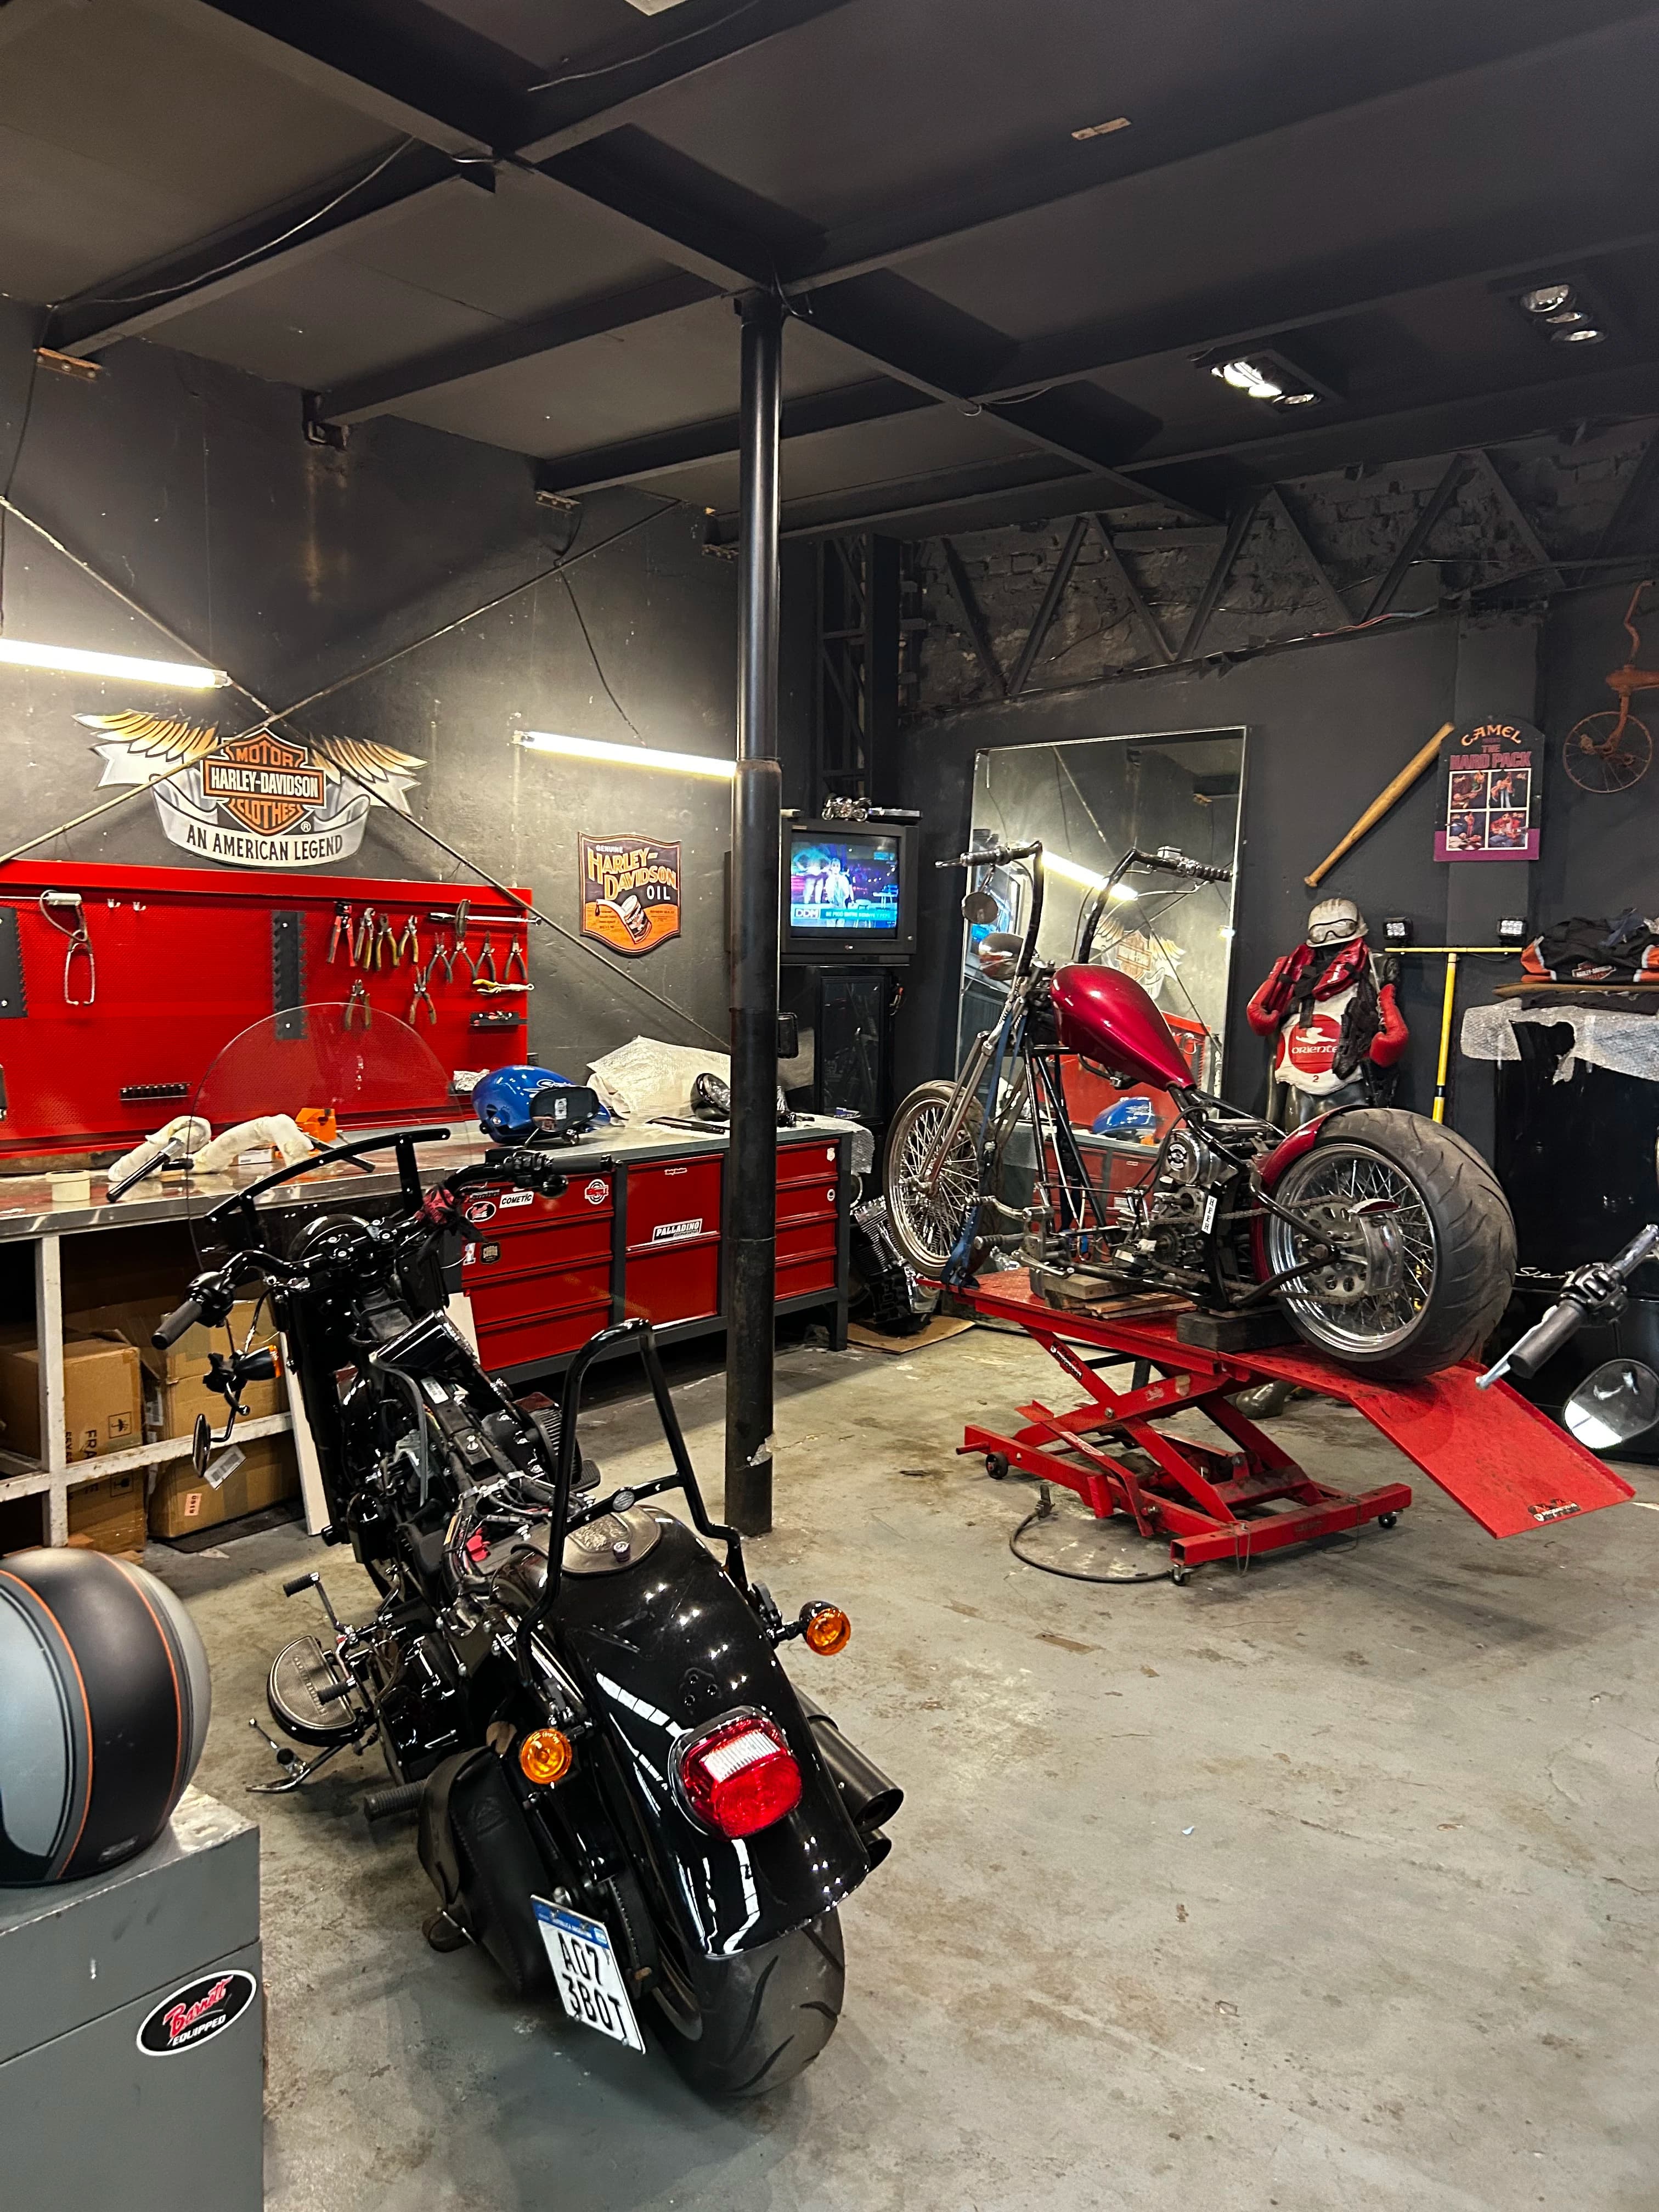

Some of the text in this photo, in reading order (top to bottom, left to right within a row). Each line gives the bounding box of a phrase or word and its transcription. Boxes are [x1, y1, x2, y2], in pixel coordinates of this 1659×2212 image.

[1461, 724, 1522, 746] CAMEL
[236, 741, 295, 766] MOTOR
[1449, 751, 1532, 770] HARD PACK
[211, 768, 319, 798] HARLEY-DAVIDSON
[237, 801, 300, 827] CLOTHES
[186, 825, 343, 861] AN AMERICAN LEGEND
[596, 844, 623, 853] GENUINE
[587, 847, 658, 885] HARLEY-
[604, 866, 678, 900] DAVIDSON
[646, 885, 670, 900] OIL
[795, 909, 819, 917] DDM
[501, 1194, 532, 1205] COMETIC
[656, 1221, 699, 1237] PALLADINO
[172, 2014, 226, 2046] EQUIPPED
